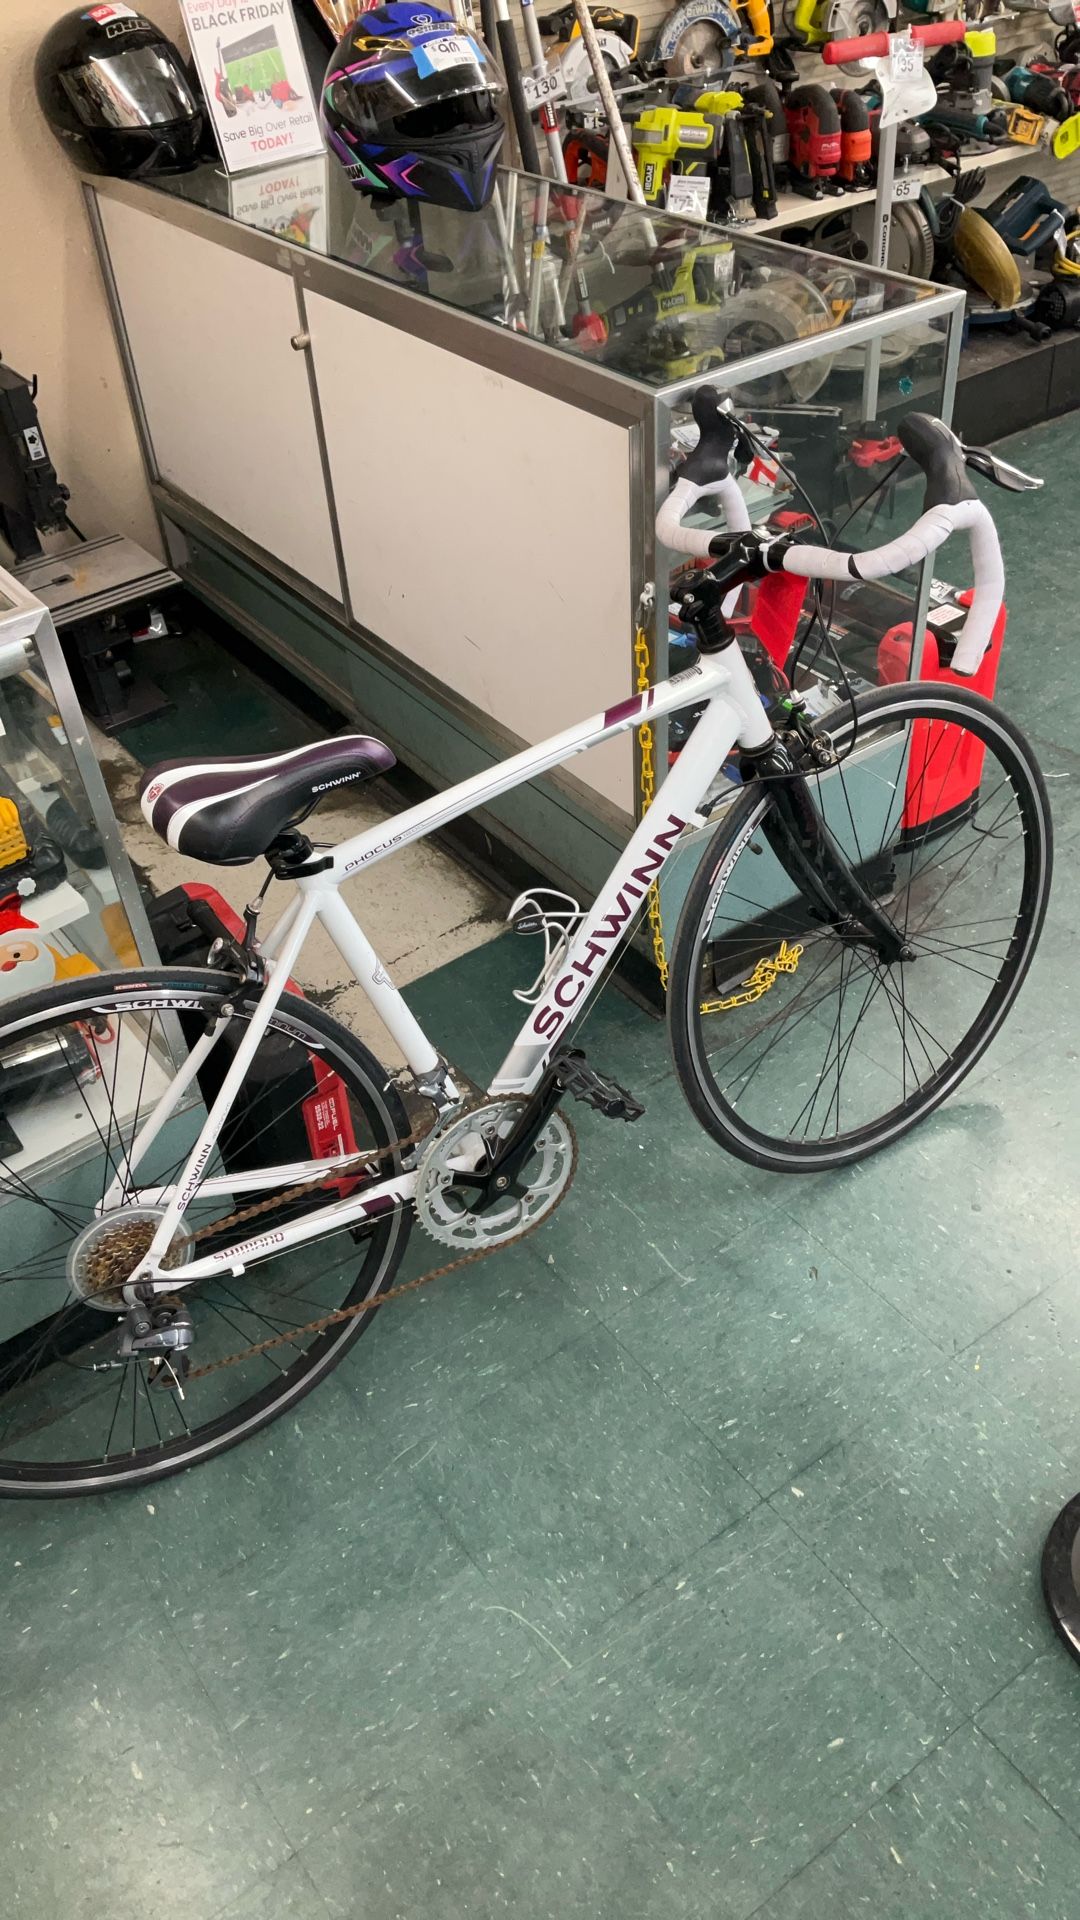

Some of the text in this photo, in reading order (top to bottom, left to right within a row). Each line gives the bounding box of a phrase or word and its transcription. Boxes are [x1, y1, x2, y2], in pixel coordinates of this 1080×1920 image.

[192, 2, 285, 31] BLACK FRIDAY
[223, 112, 314, 142] Save Big Over Retail
[250, 132, 294, 152] TODAY!
[644, 165, 654, 191] RYOBI
[896, 183, 911, 196] 65
[311, 772, 360, 793] SCHWINN
[344, 835, 402, 872] PHOCUS
[533, 814, 687, 1041] SCHWINN
[177, 1143, 212, 1211] SCHWINN
[213, 1232, 285, 1263] SHIMANO
